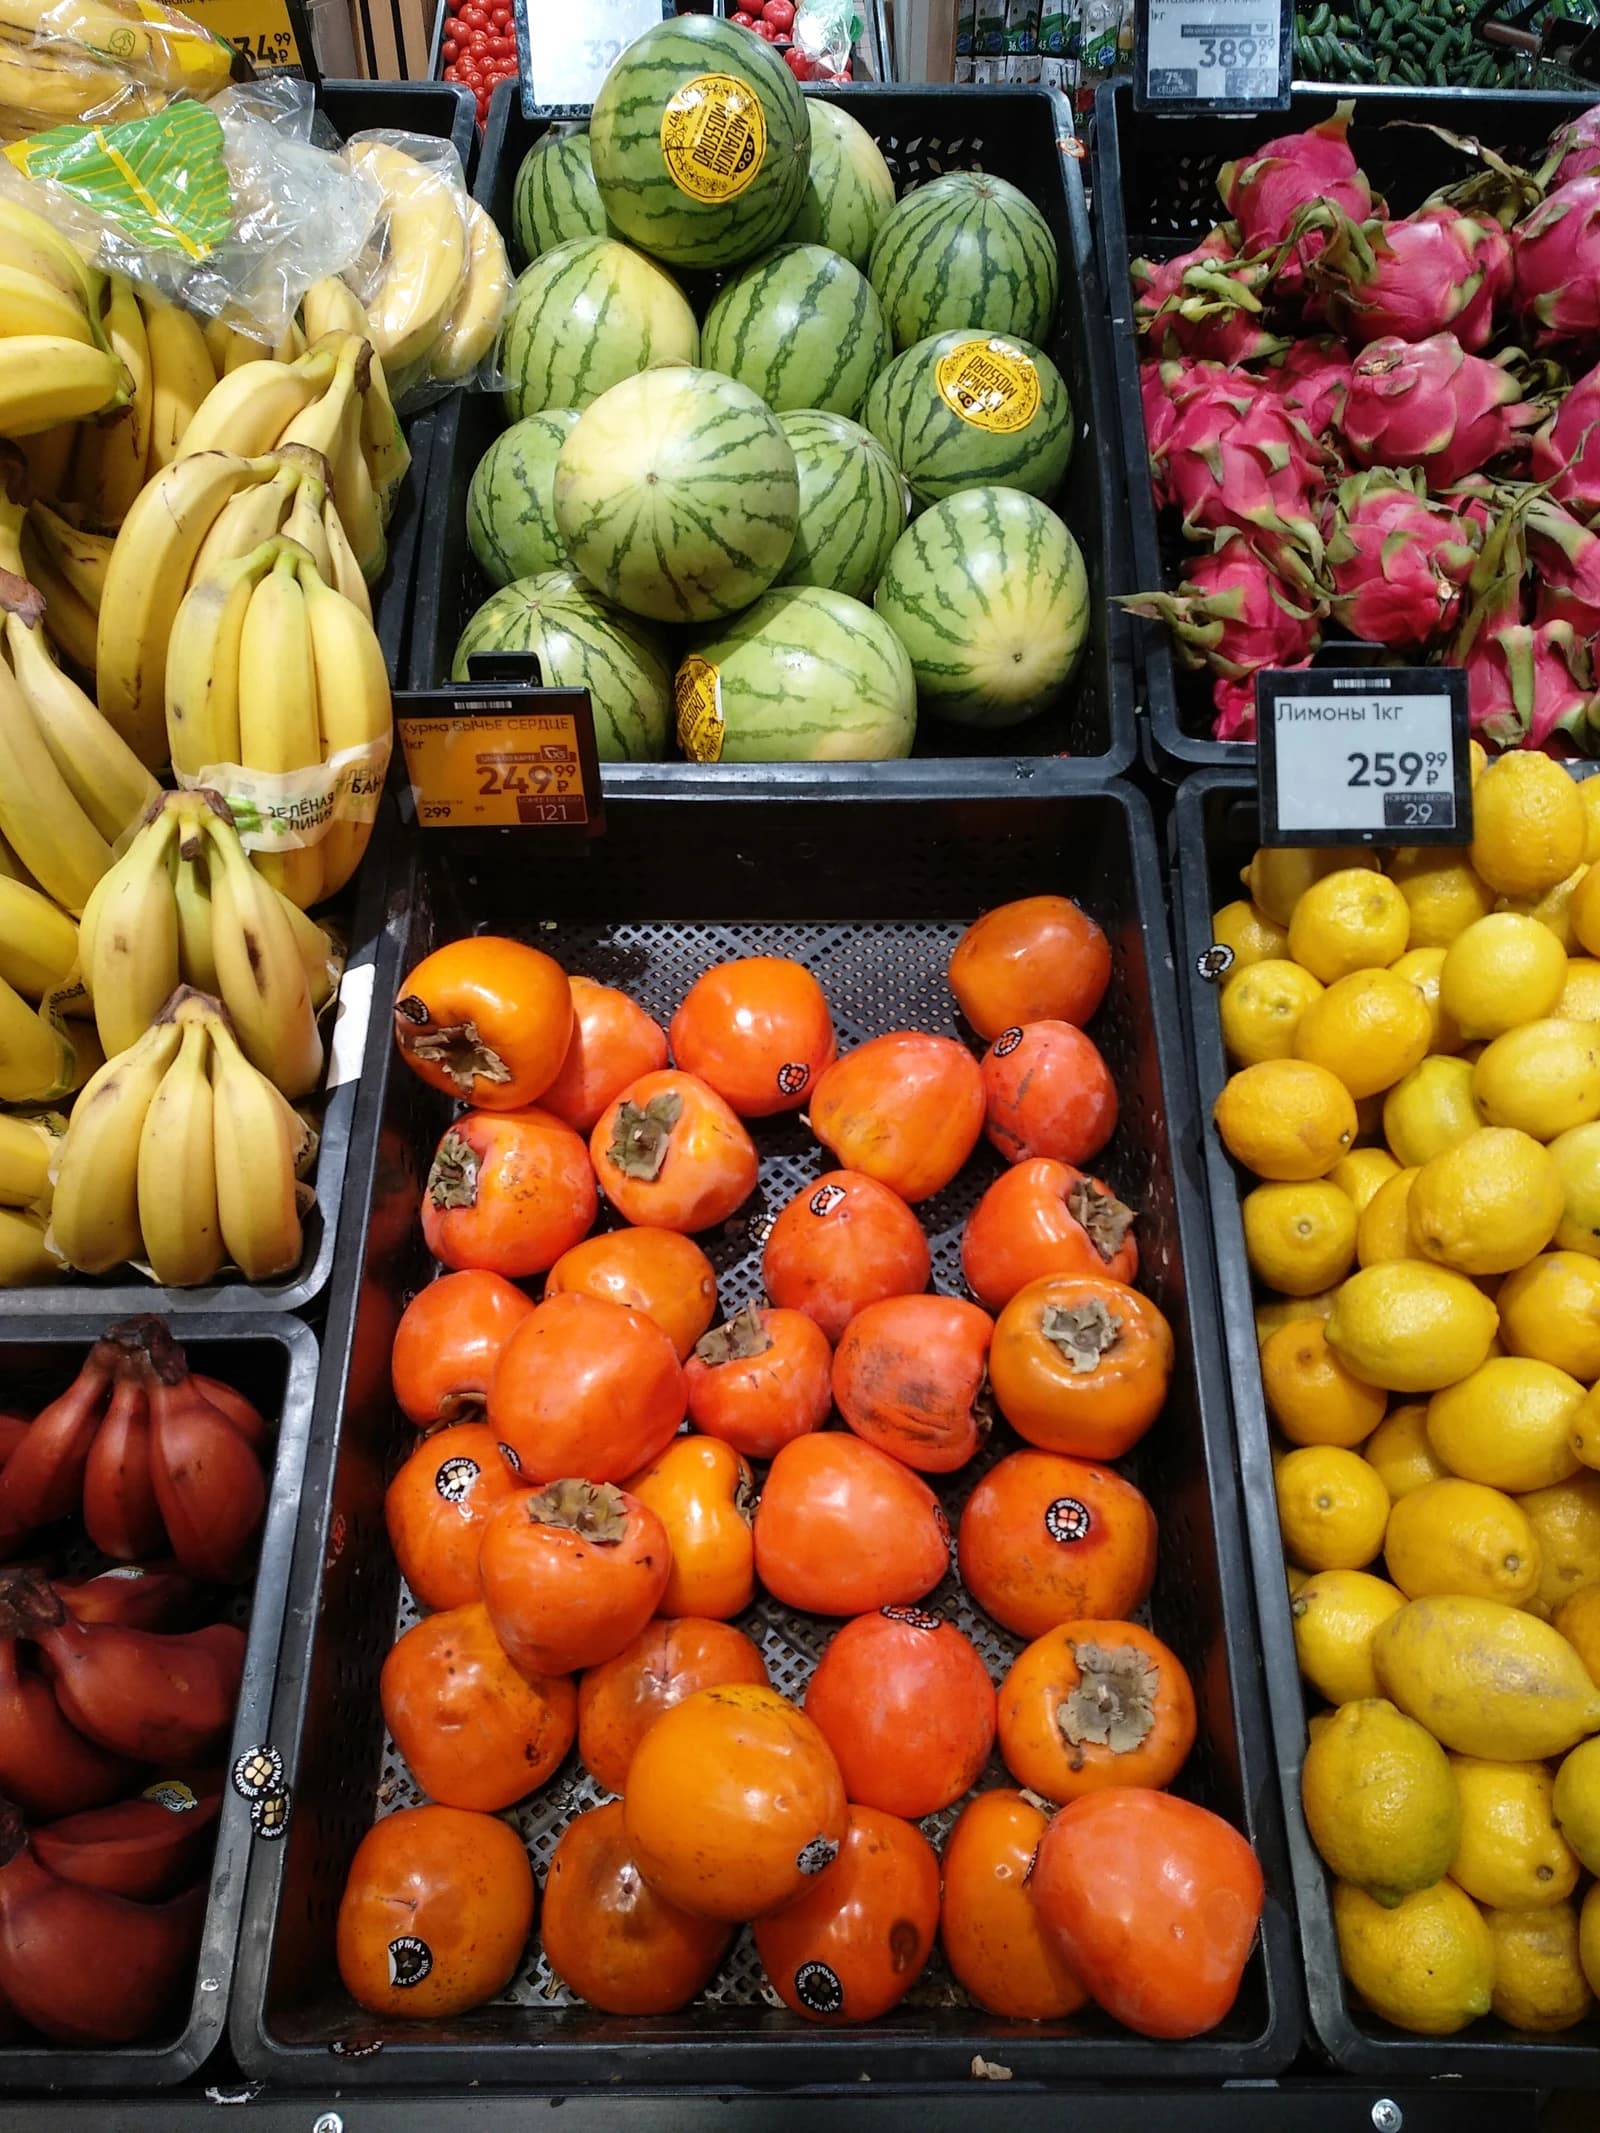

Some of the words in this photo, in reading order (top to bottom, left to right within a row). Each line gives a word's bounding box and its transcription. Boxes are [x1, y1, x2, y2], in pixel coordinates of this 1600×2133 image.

[230, 34, 278, 64] 34
[273, 32, 291, 46] 99
[1199, 39, 1257, 68] 389
[1277, 703, 1366, 721] Лимоны
[1372, 703, 1403, 721] 1кг
[507, 718, 569, 731] СЕРДЦЕ
[476, 765, 553, 795] 249
[554, 764, 576, 778] 99
[1347, 752, 1424, 787] 259
[1425, 751, 1447, 767] 99
[423, 806, 451, 818] 299
[536, 804, 567, 821] 121
[1404, 803, 1432, 824] 29
[267, 1744, 282, 1788] ХУРМА
[808, 1997, 840, 2012] ХУРМА
